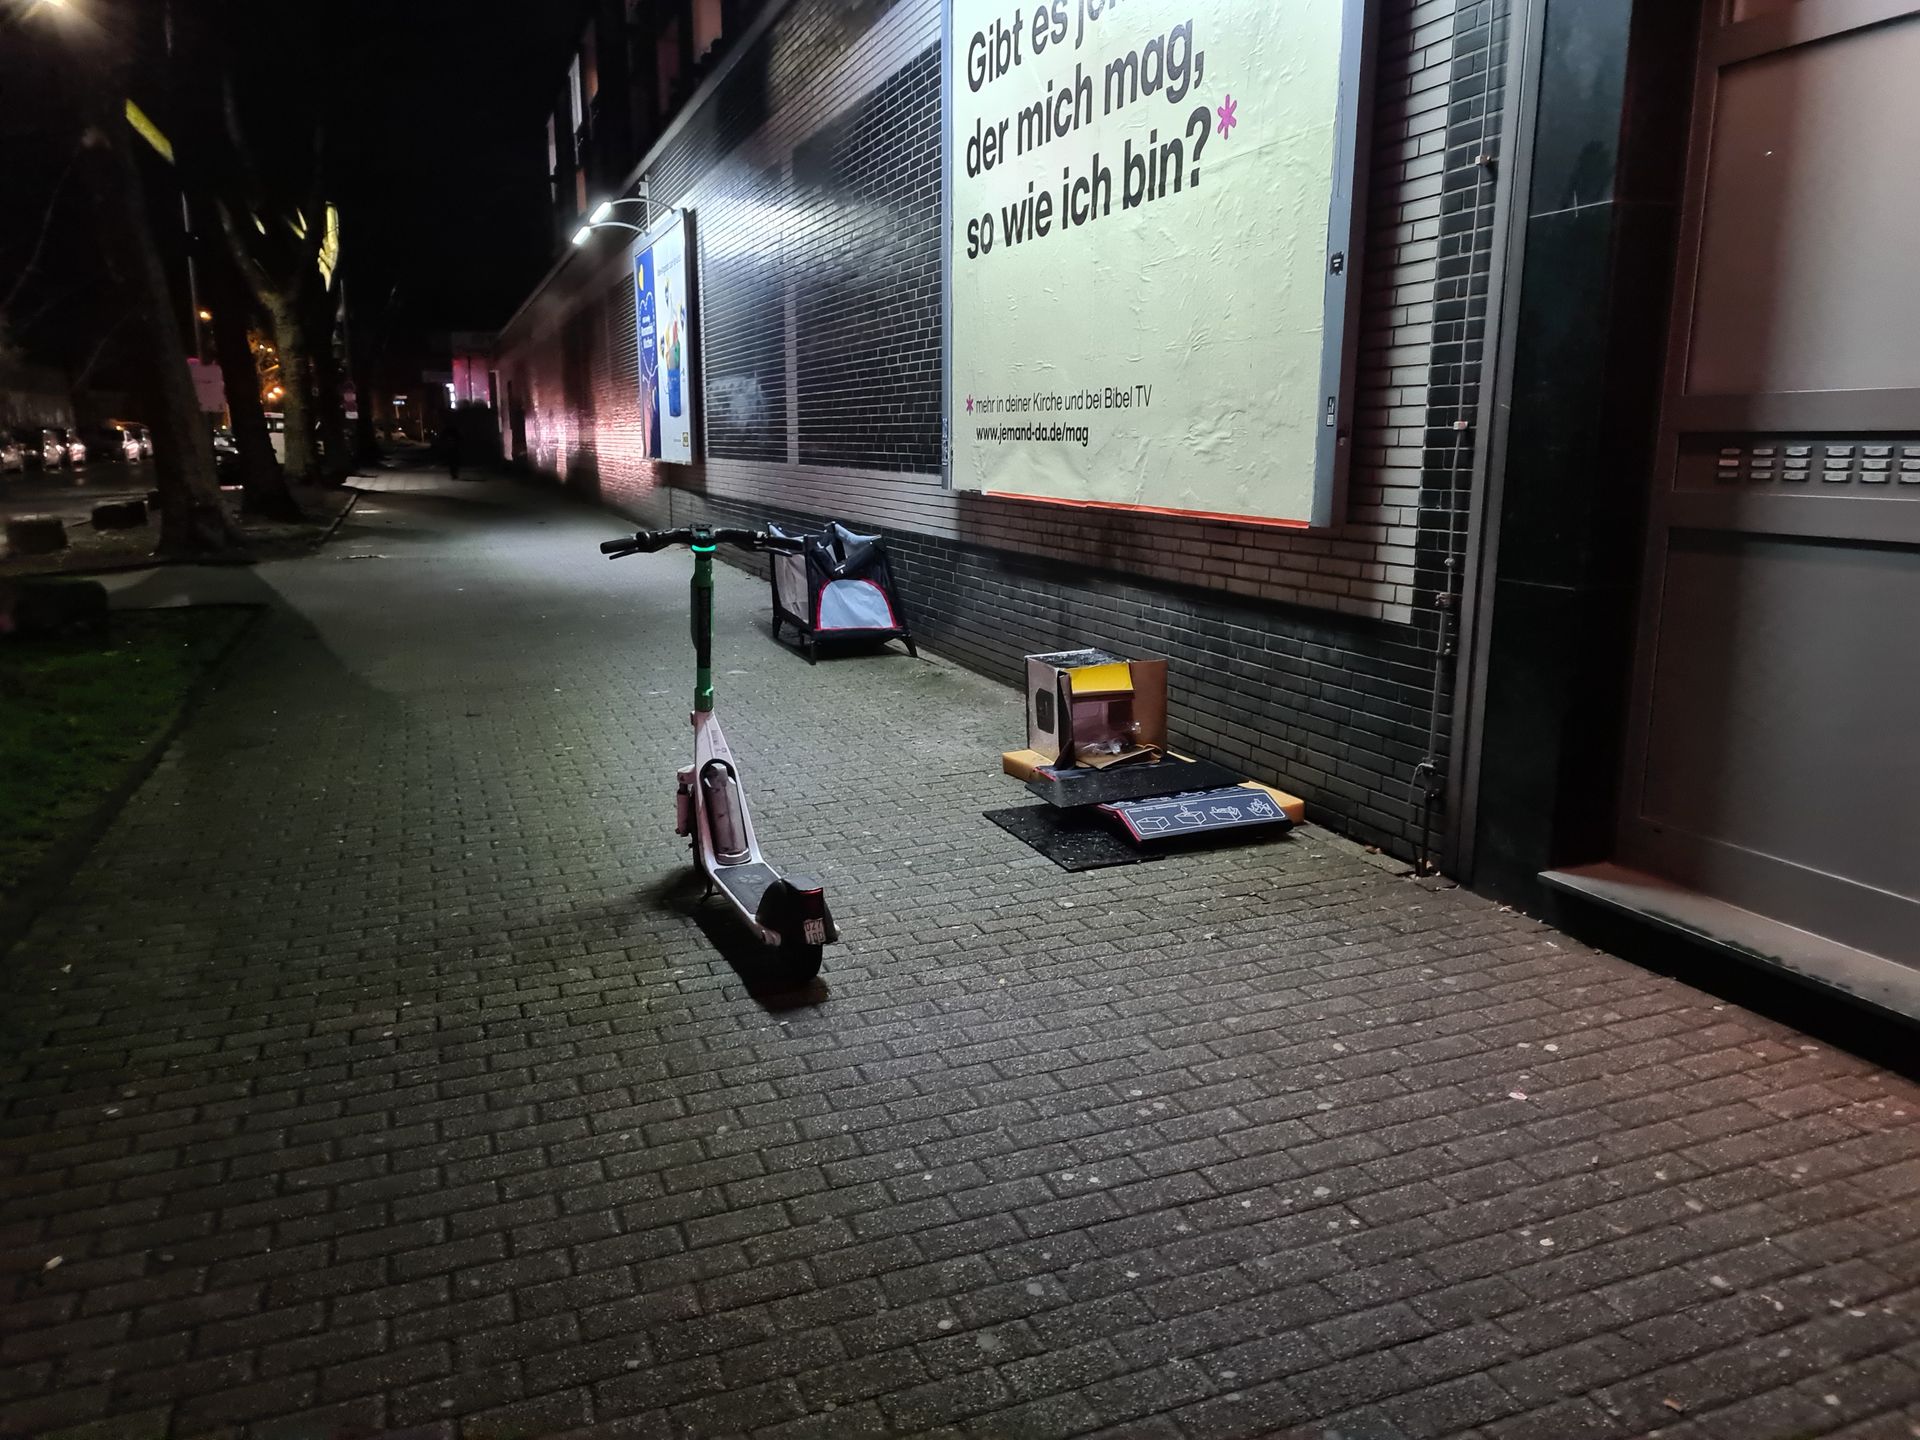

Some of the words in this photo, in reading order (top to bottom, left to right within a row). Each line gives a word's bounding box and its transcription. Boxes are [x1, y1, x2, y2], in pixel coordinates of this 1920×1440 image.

[967, 8, 1023, 93] Gibt
[1031, 0, 1068, 55] es
[967, 117, 1009, 179] der
[1018, 62, 1093, 156] mich
[1103, 18, 1206, 116] mag,
[967, 212, 995, 260] so
[1002, 180, 1053, 248] wie
[1062, 152, 1112, 231] ich
[1122, 106, 1212, 211] bin?
[976, 395, 995, 414] mehr
[996, 395, 1004, 413] in
[1005, 394, 1031, 413] deiner
[1032, 391, 1063, 412] Kirche
[1064, 389, 1084, 410] und
[1085, 388, 1102, 410] bei
[1104, 385, 1133, 409] Bibel
[1135, 384, 1152, 407] TV
[976, 421, 1089, 447] www.jemand-da.de/mag
